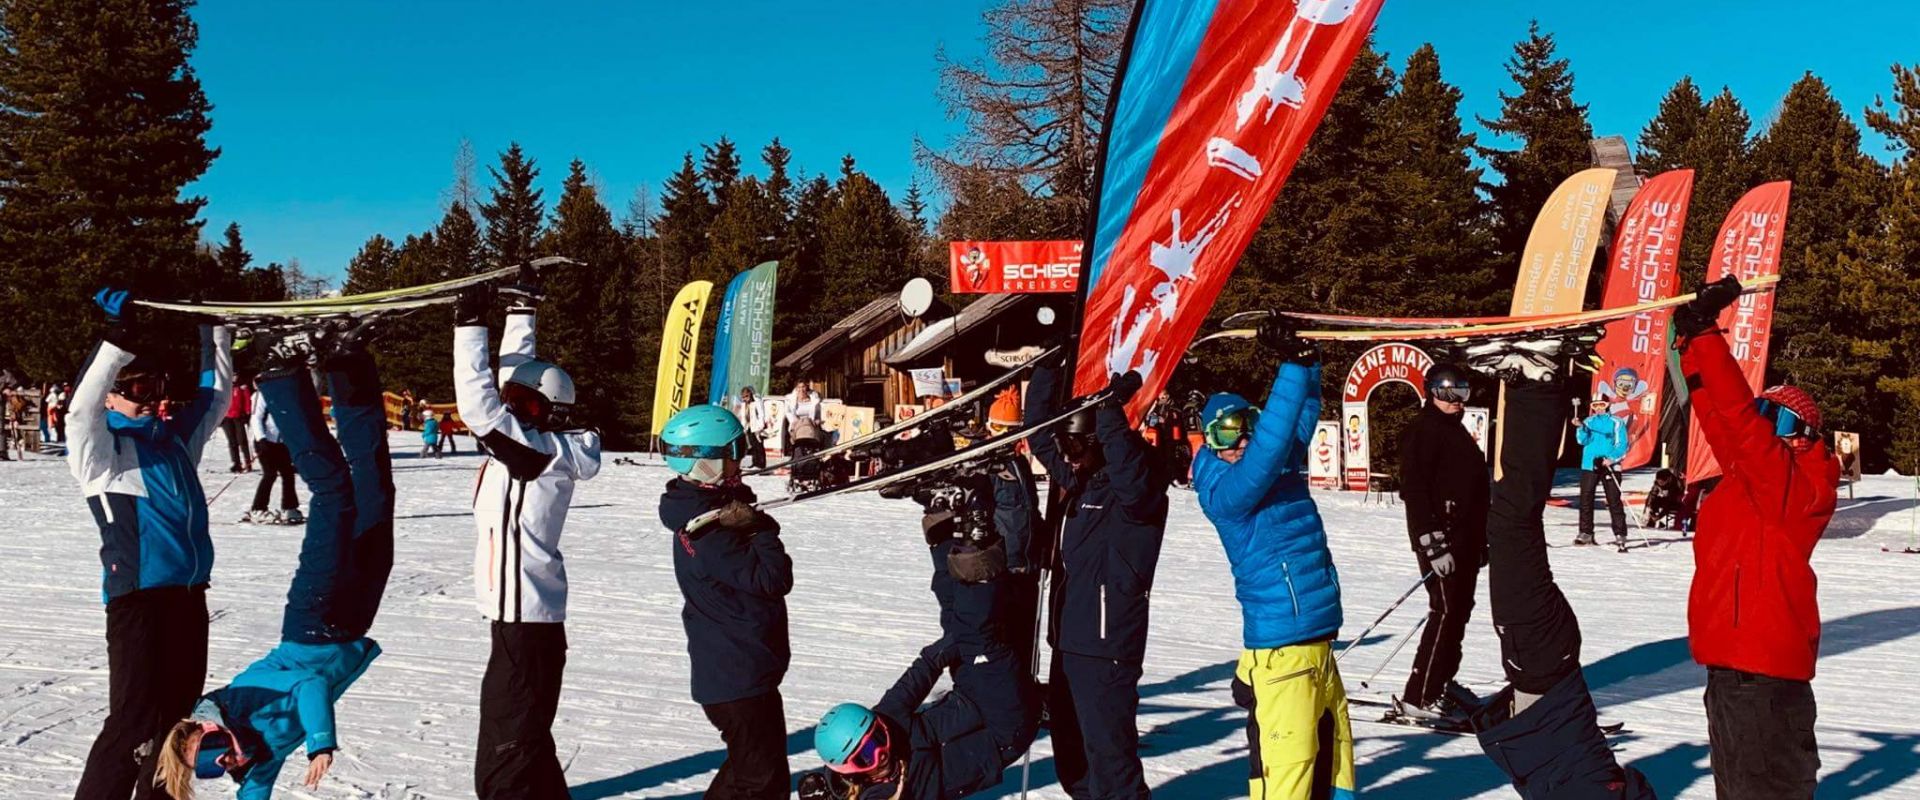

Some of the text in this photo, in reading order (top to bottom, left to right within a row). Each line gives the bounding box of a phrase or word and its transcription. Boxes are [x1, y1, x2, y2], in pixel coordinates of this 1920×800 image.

[1565, 183, 1599, 289] SCHISCHULE
[1620, 217, 1638, 270] MAYER
[1721, 228, 1738, 279] MAYER
[1003, 263, 1080, 279] SCHISC
[1003, 280, 1072, 290] KREISC
[1547, 251, 1564, 301] lessons
[1632, 201, 1670, 354] SCHISCHULE
[1651, 202, 1681, 356] KREISCHBERG
[750, 281, 766, 377] SCHISCHULE
[1347, 349, 1386, 398] BIENE
[1378, 364, 1409, 379] LAND
